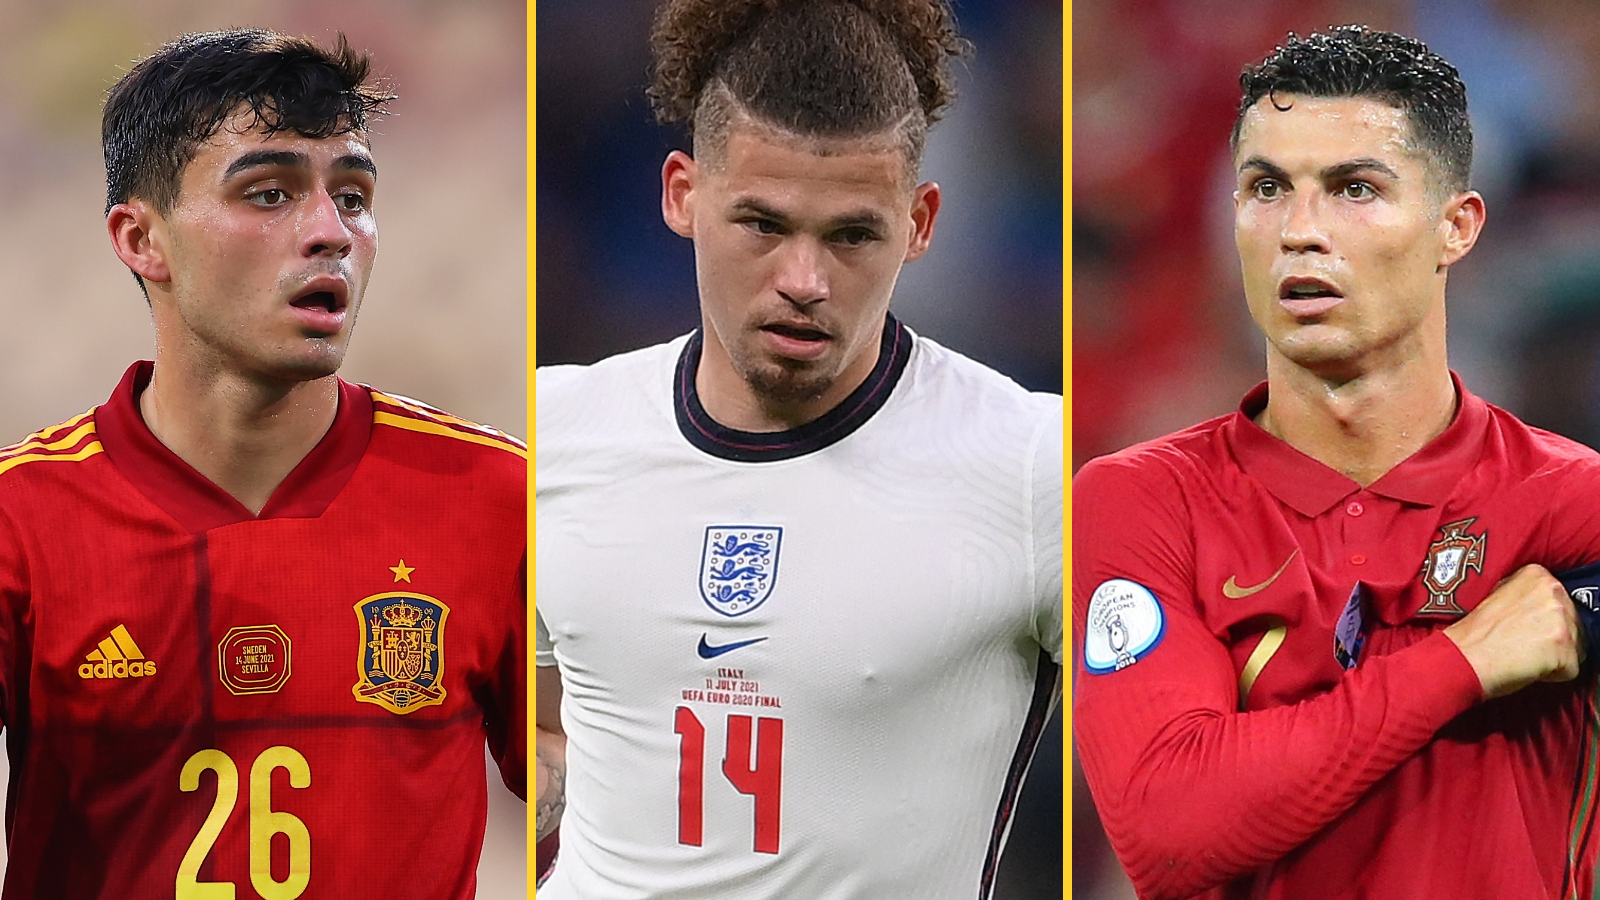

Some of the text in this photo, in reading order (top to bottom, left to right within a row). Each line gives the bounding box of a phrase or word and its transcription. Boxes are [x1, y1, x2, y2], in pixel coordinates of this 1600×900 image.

[242, 644, 267, 655] SWEDEN
[235, 653, 275, 665] 14 JUNE 2021
[78, 658, 157, 679] adidas
[241, 664, 269, 674] SEVILLA
[717, 668, 744, 679] ITALY
[706, 678, 759, 693] 11 JULY 2021
[682, 690, 782, 708] UEFA EURO 2020 FINAL
[674, 705, 783, 855] 14
[175, 745, 312, 900] 26
